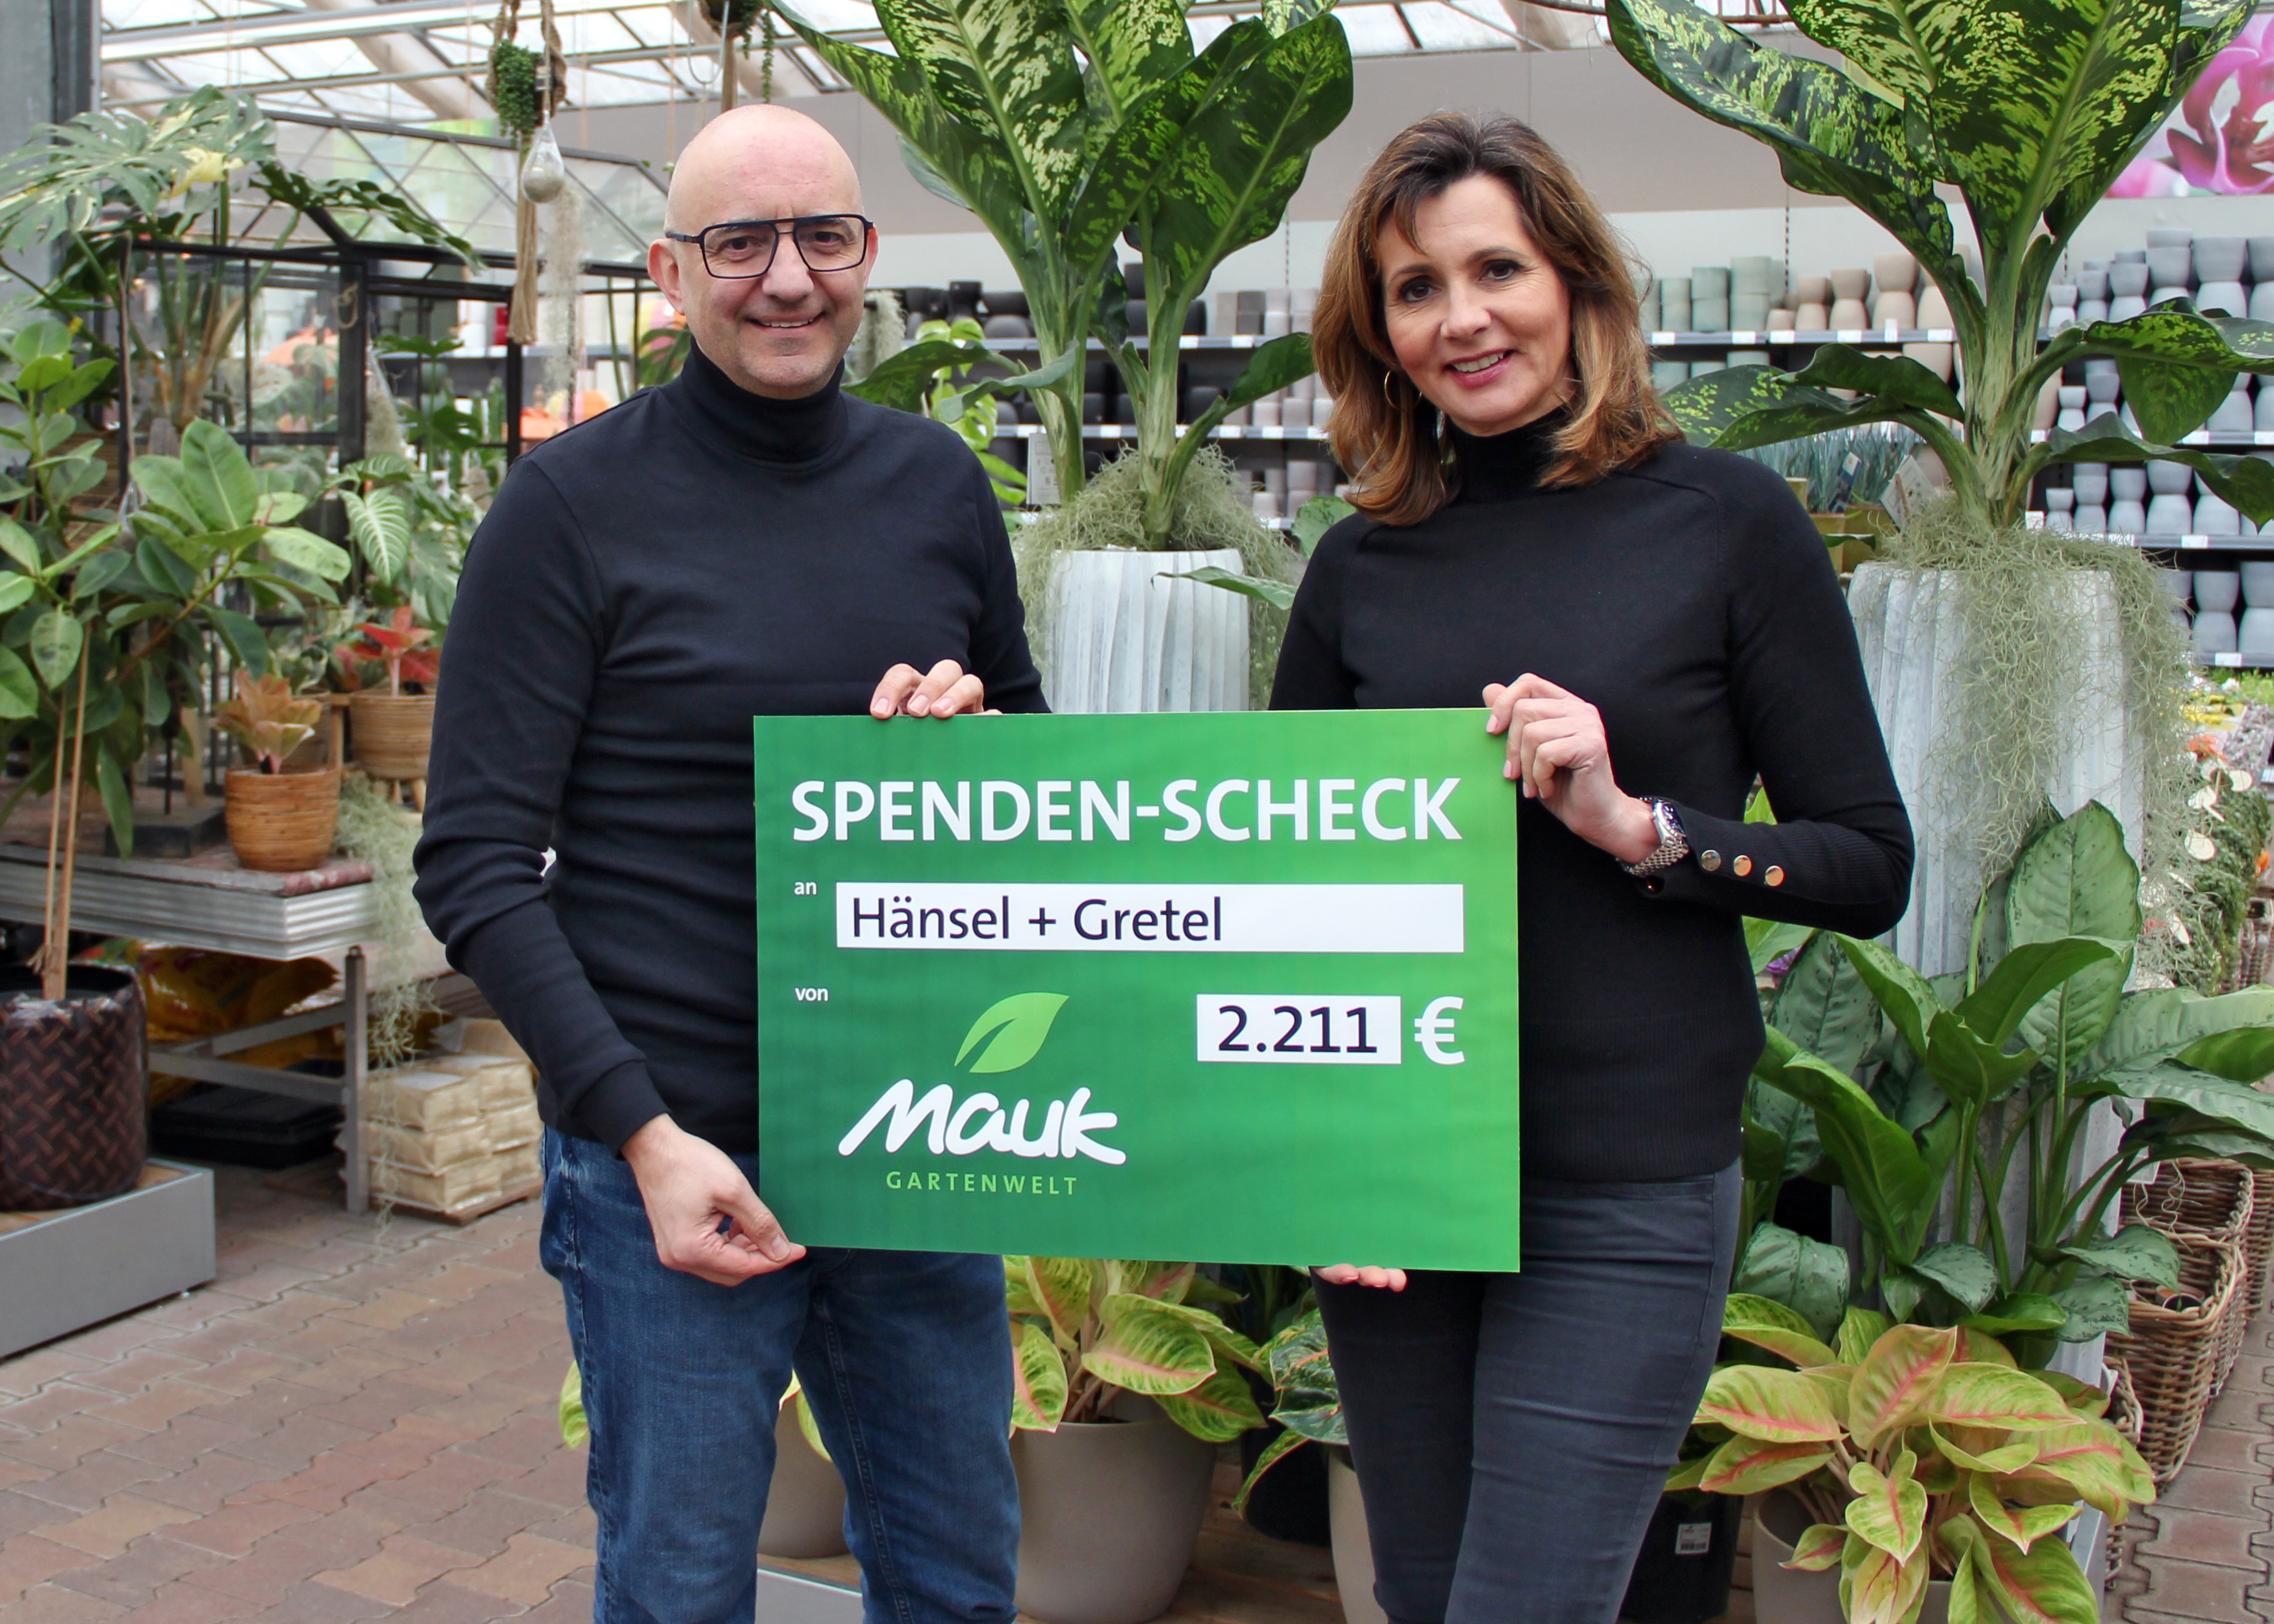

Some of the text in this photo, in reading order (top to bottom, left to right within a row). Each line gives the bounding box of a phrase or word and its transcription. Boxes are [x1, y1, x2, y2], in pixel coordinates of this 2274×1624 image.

[792, 777, 1463, 842] SPENDEN-SCHECK
[794, 882, 817, 896] an
[853, 895, 1221, 942] Hänsel + Gretel
[795, 988, 829, 1003] von
[1219, 996, 1466, 1066] 2.211 €
[838, 1079, 1127, 1166] Mauk
[885, 1170, 1078, 1195] GARTENWELT
